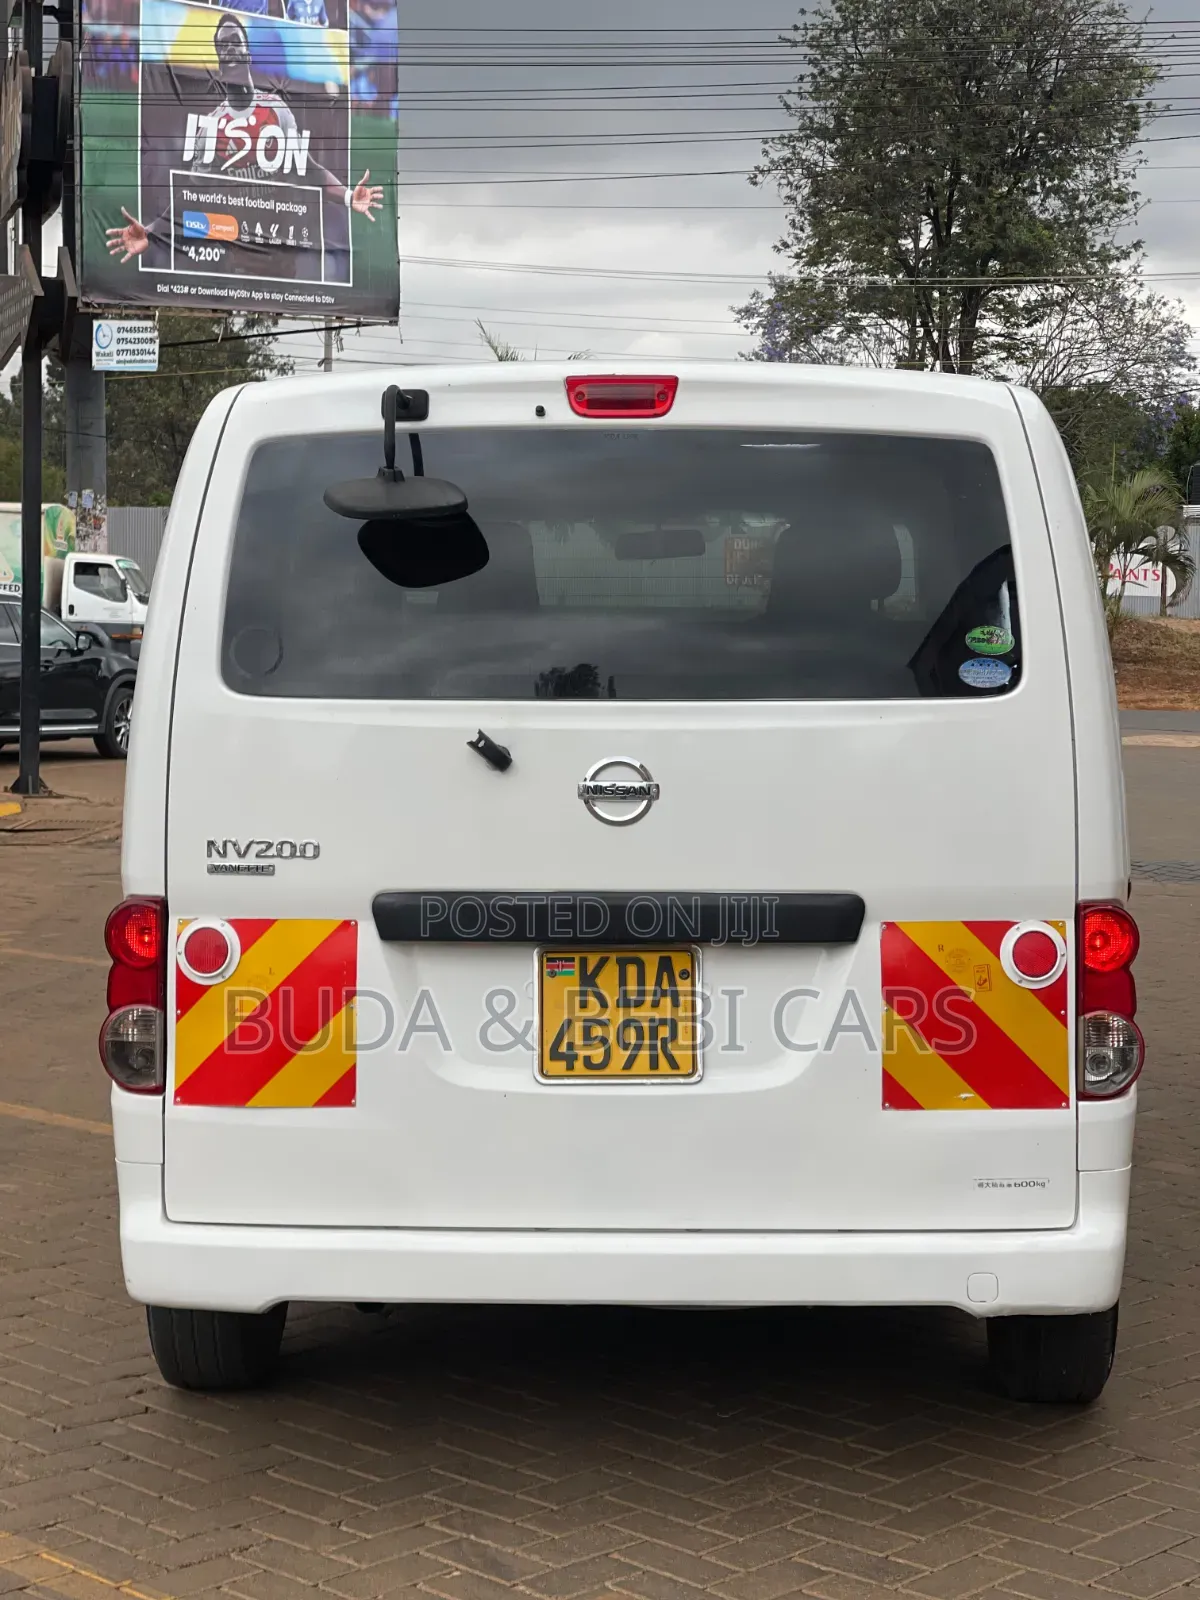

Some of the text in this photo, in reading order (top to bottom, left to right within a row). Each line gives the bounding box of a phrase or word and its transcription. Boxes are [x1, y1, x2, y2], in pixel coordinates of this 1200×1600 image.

[183, 113, 311, 176] IT'S ON
[182, 190, 307, 216] The world's best football package
[188, 245, 220, 262] 4,200
[156, 284, 169, 293] Dial
[197, 286, 228, 297] Download
[251, 290, 263, 300] App
[263, 291, 270, 299] to
[271, 292, 284, 303] stay
[284, 293, 314, 303] Connected
[315, 295, 321, 303] to
[1107, 562, 1160, 582] ANTS
[586, 784, 651, 796] NISSAN
[206, 839, 320, 860] NV200
[579, 956, 680, 1009] KDA
[549, 1018, 680, 1071] 459R
